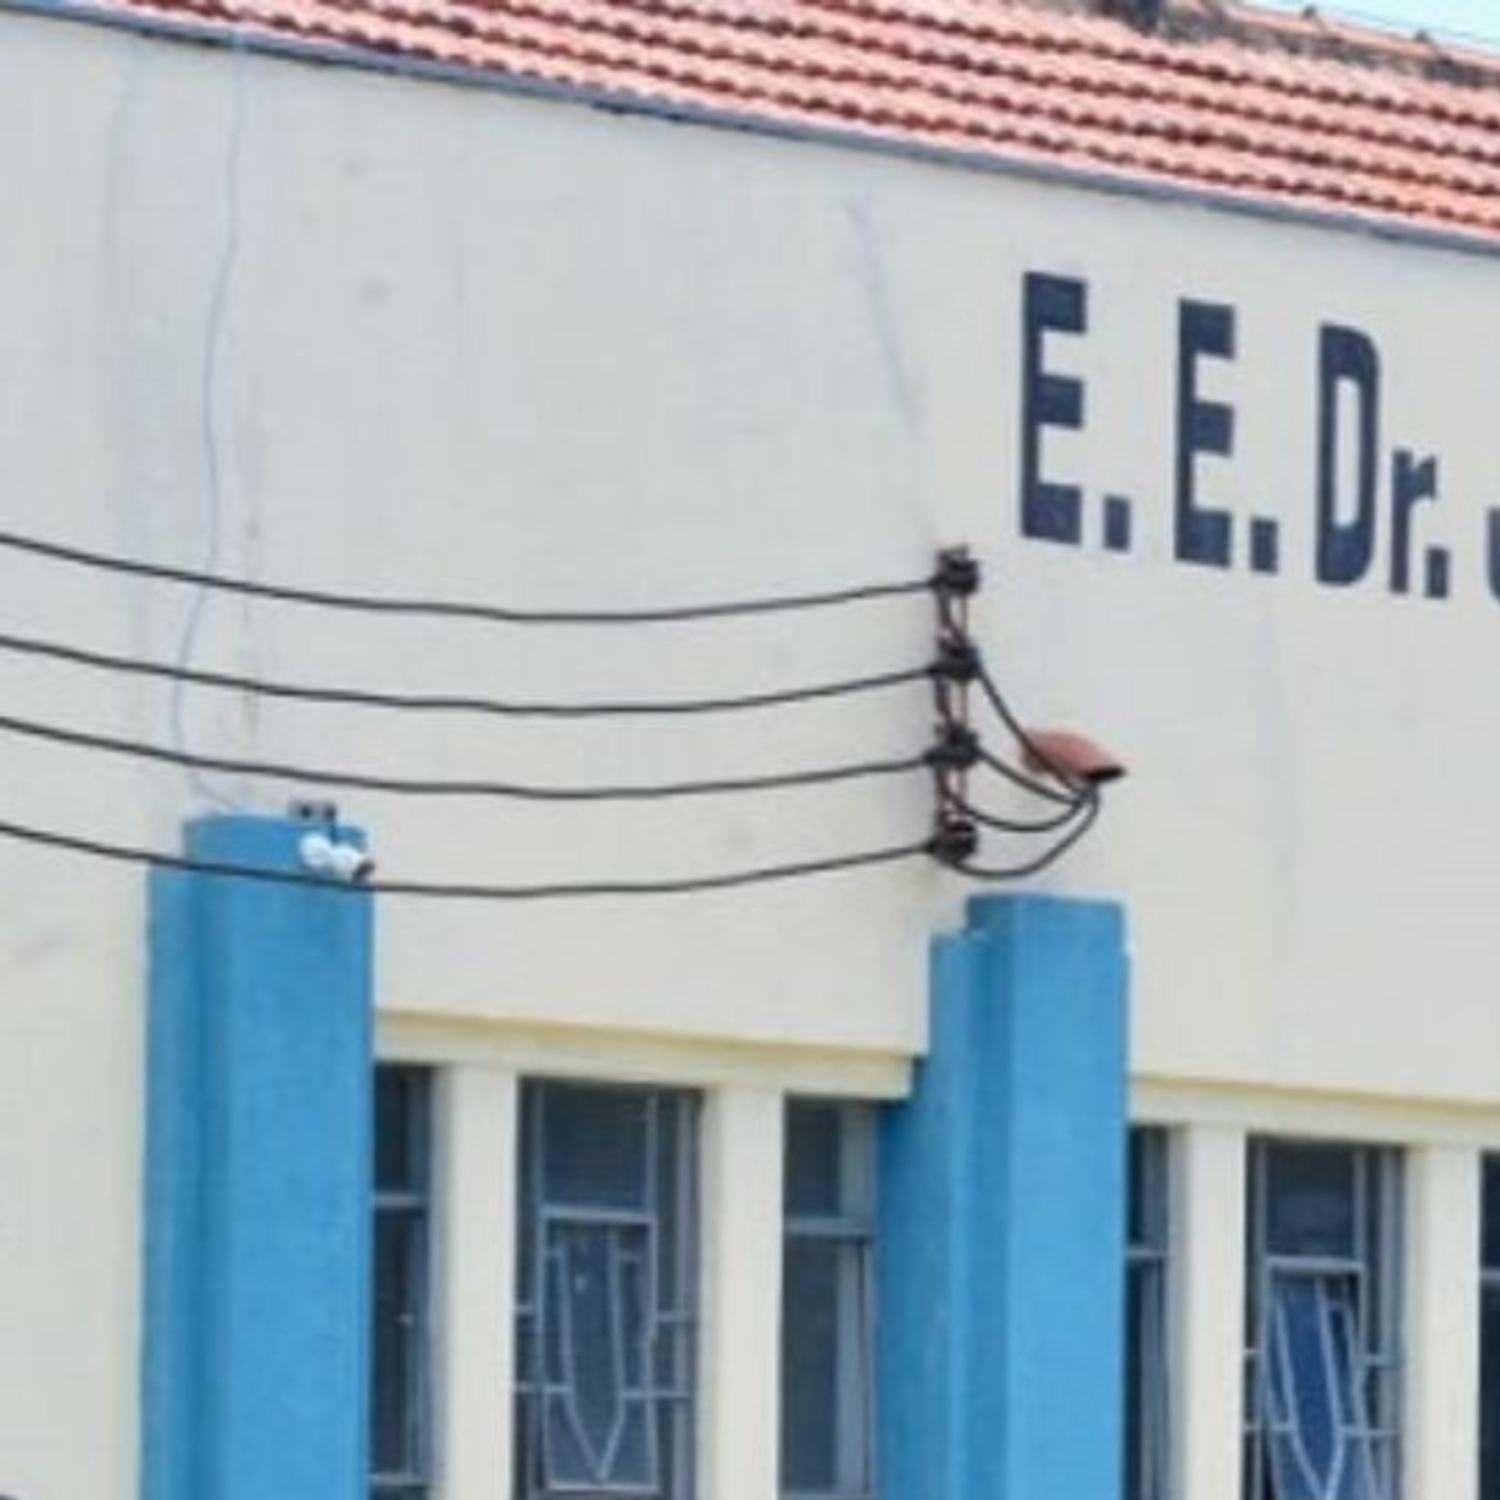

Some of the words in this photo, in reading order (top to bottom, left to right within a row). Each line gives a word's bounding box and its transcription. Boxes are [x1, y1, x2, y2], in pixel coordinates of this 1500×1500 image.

[1018, 270, 1132, 552] E.
[1173, 298, 1280, 575] E.
[1314, 323, 1450, 600] Dr.
